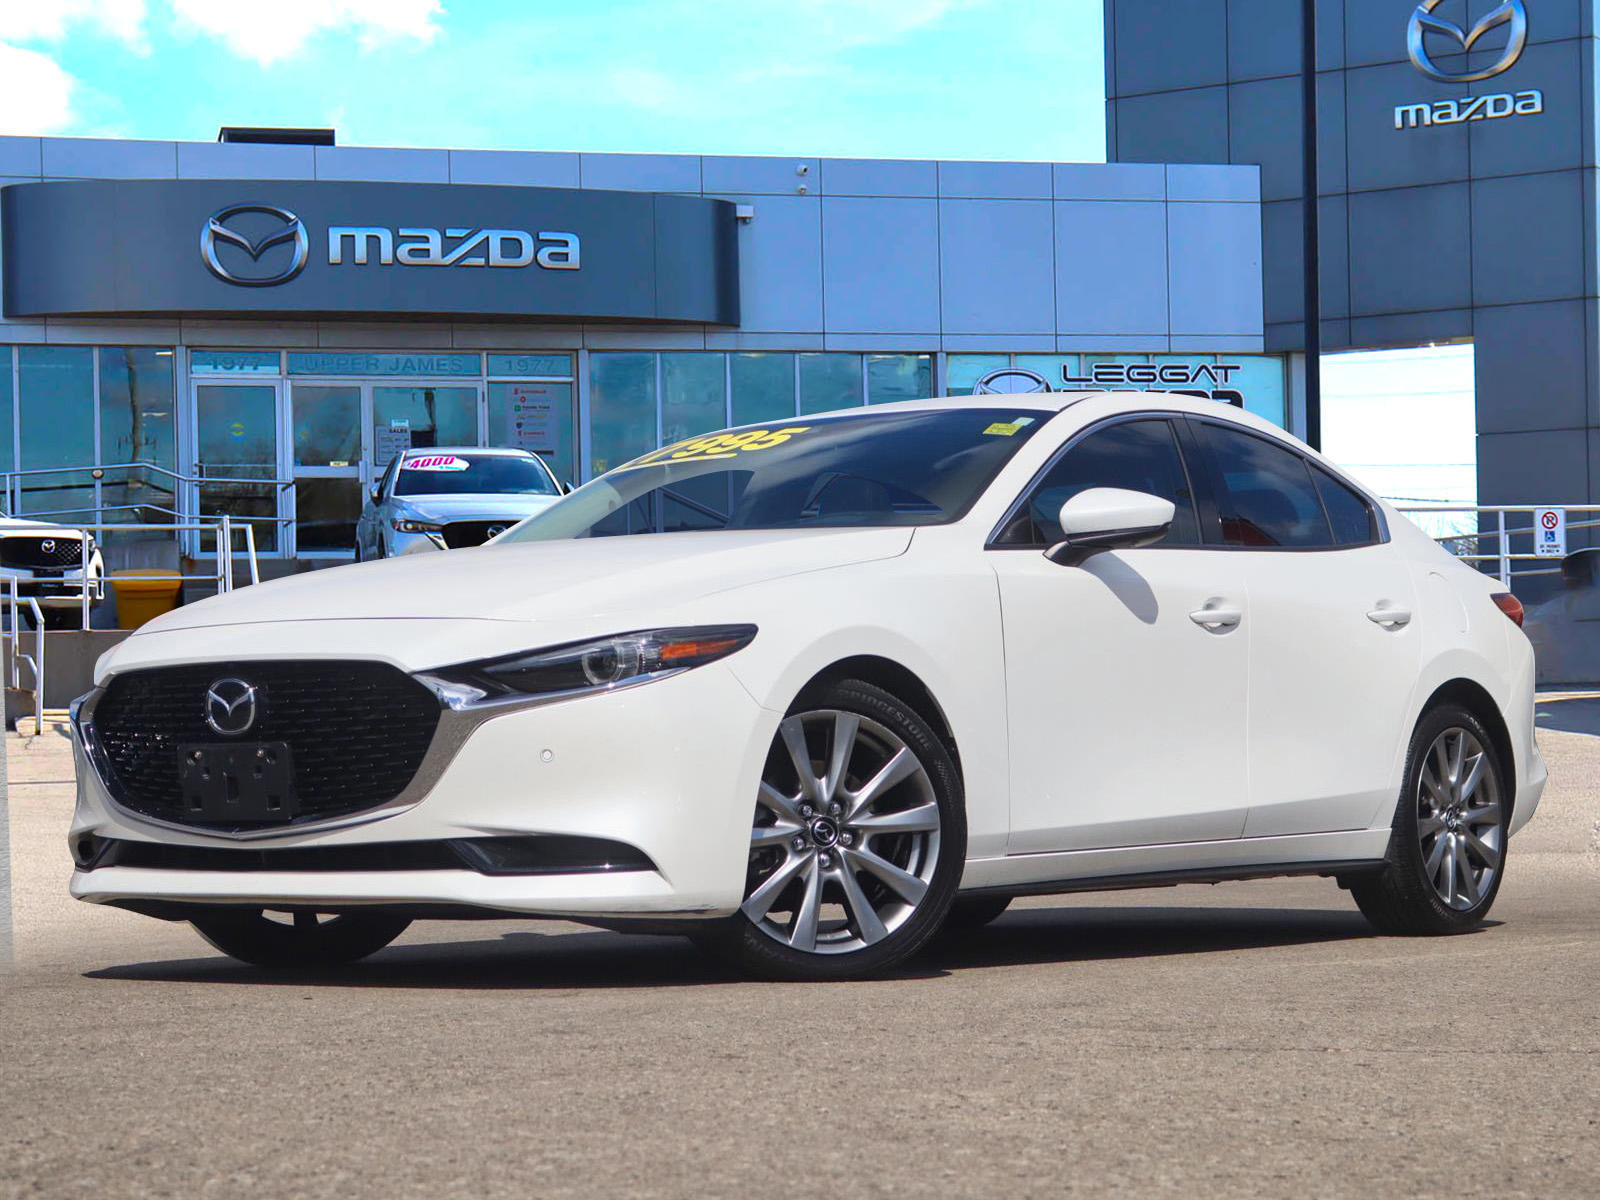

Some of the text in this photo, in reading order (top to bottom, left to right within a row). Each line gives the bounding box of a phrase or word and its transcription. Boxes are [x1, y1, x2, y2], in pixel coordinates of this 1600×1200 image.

[304, 355, 464, 373] UPPER JAMES
[504, 358, 555, 373] 1977
[1061, 363, 1242, 385] LEGGAT
